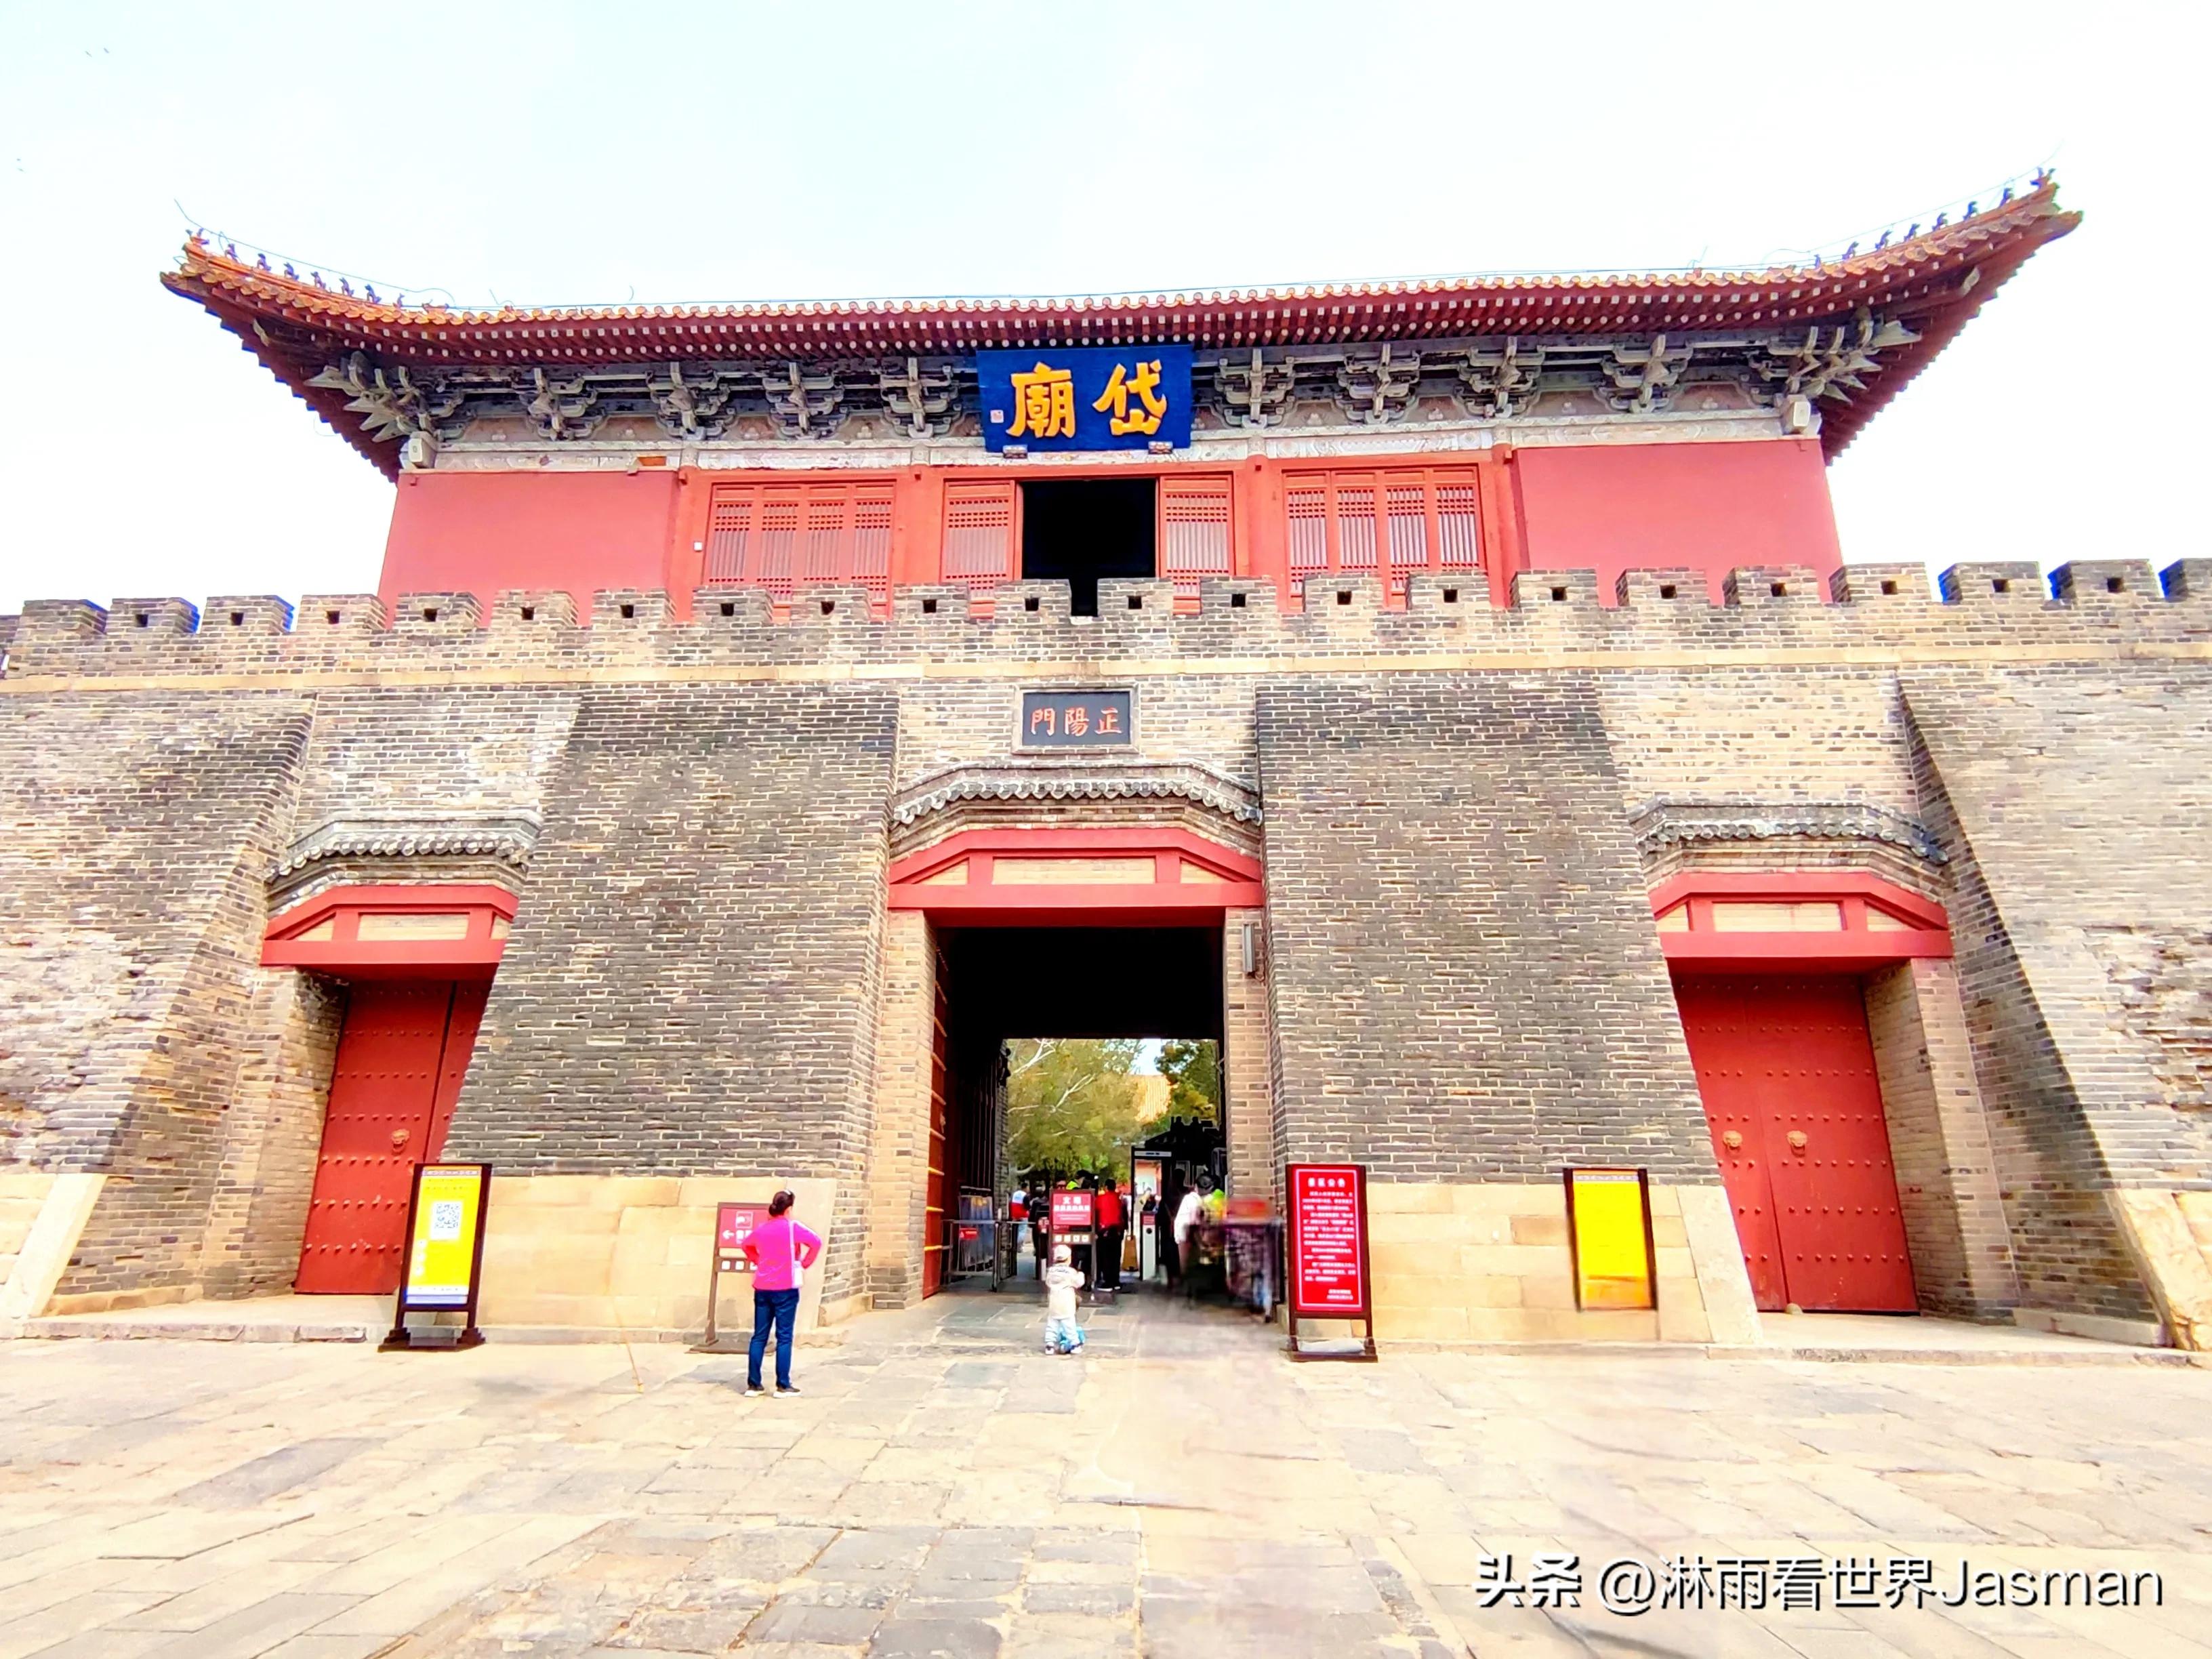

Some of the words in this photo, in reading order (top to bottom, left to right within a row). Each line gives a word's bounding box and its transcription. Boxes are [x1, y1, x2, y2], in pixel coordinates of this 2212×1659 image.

[1006, 360, 1168, 438] 岱廟
[1031, 707, 1122, 737] 正陽門
